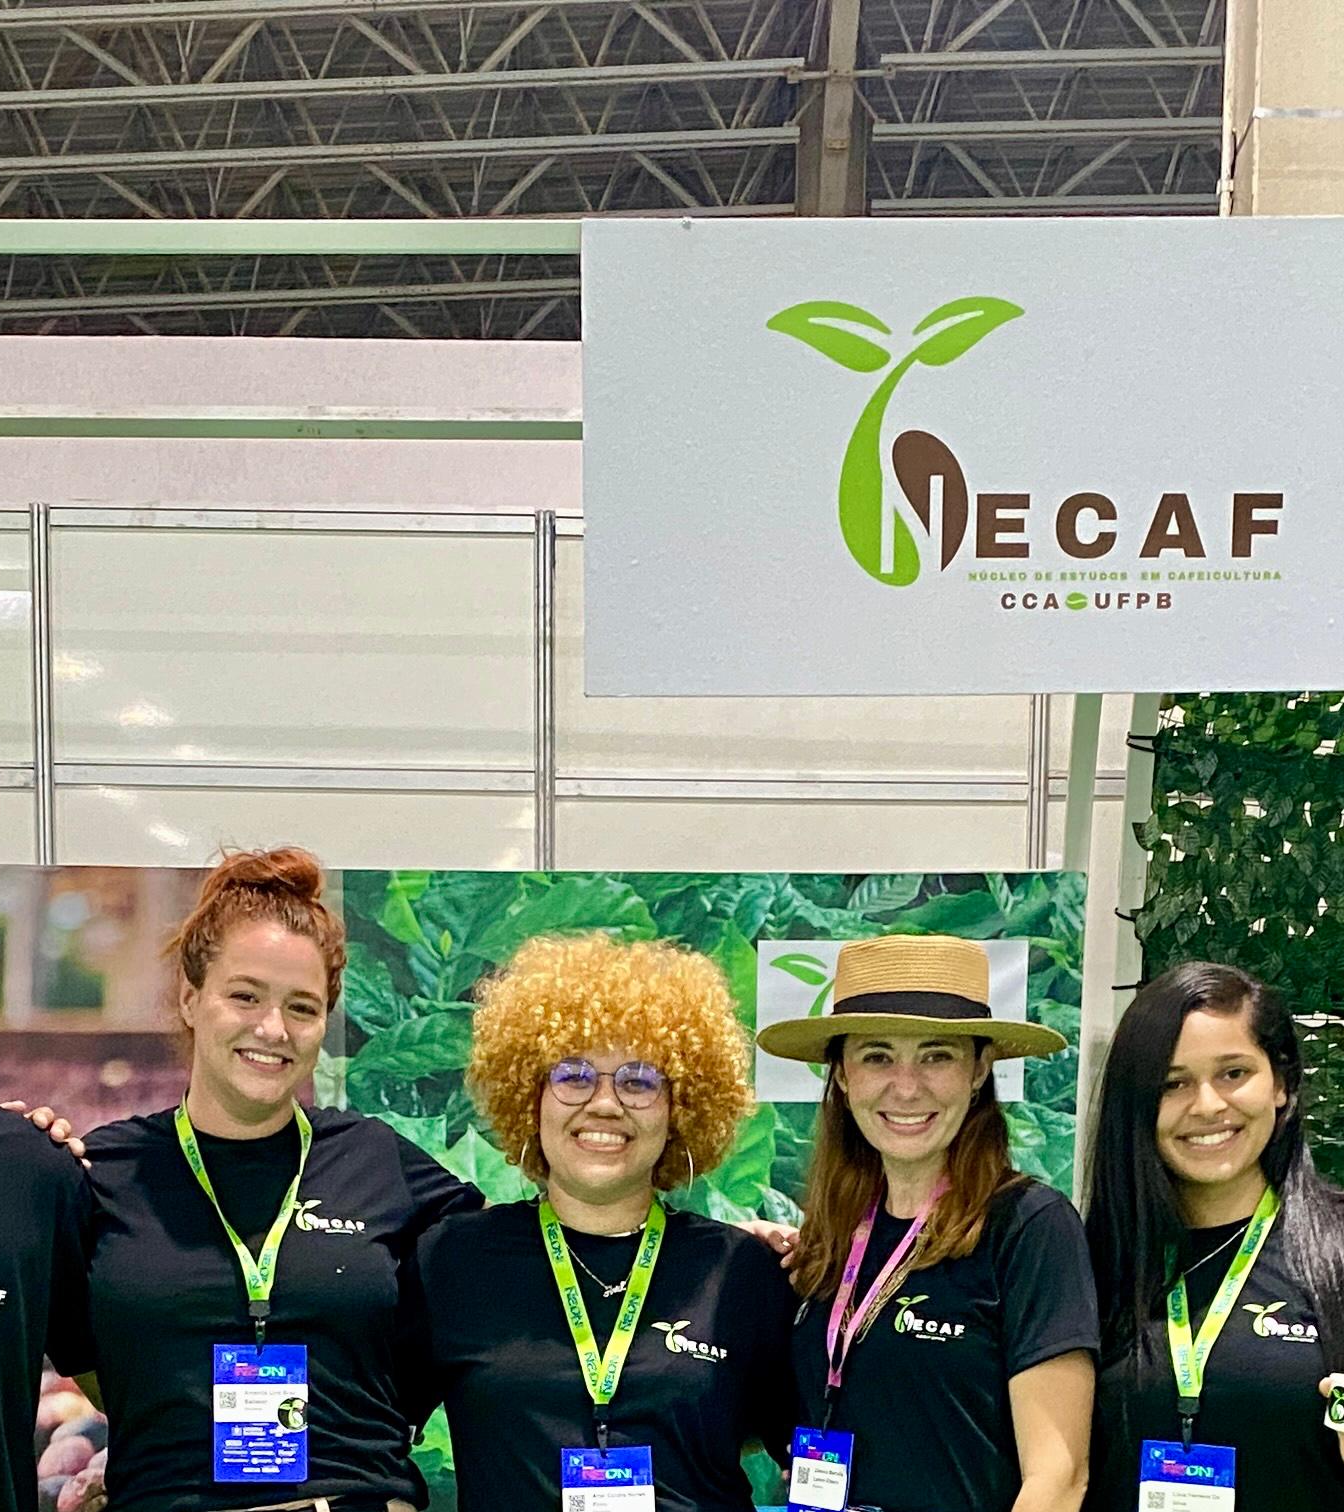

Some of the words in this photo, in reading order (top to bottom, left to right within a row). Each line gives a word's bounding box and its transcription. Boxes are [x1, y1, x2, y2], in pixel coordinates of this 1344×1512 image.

[1034, 571, 1053, 582] DE
[1059, 571, 1129, 582] ESTUDOS
[1140, 571, 1161, 581] EM
[1167, 570, 1283, 581] CAFEICULTURA
[1000, 592, 1060, 611] CCA
[1093, 592, 1173, 611] UFPB
